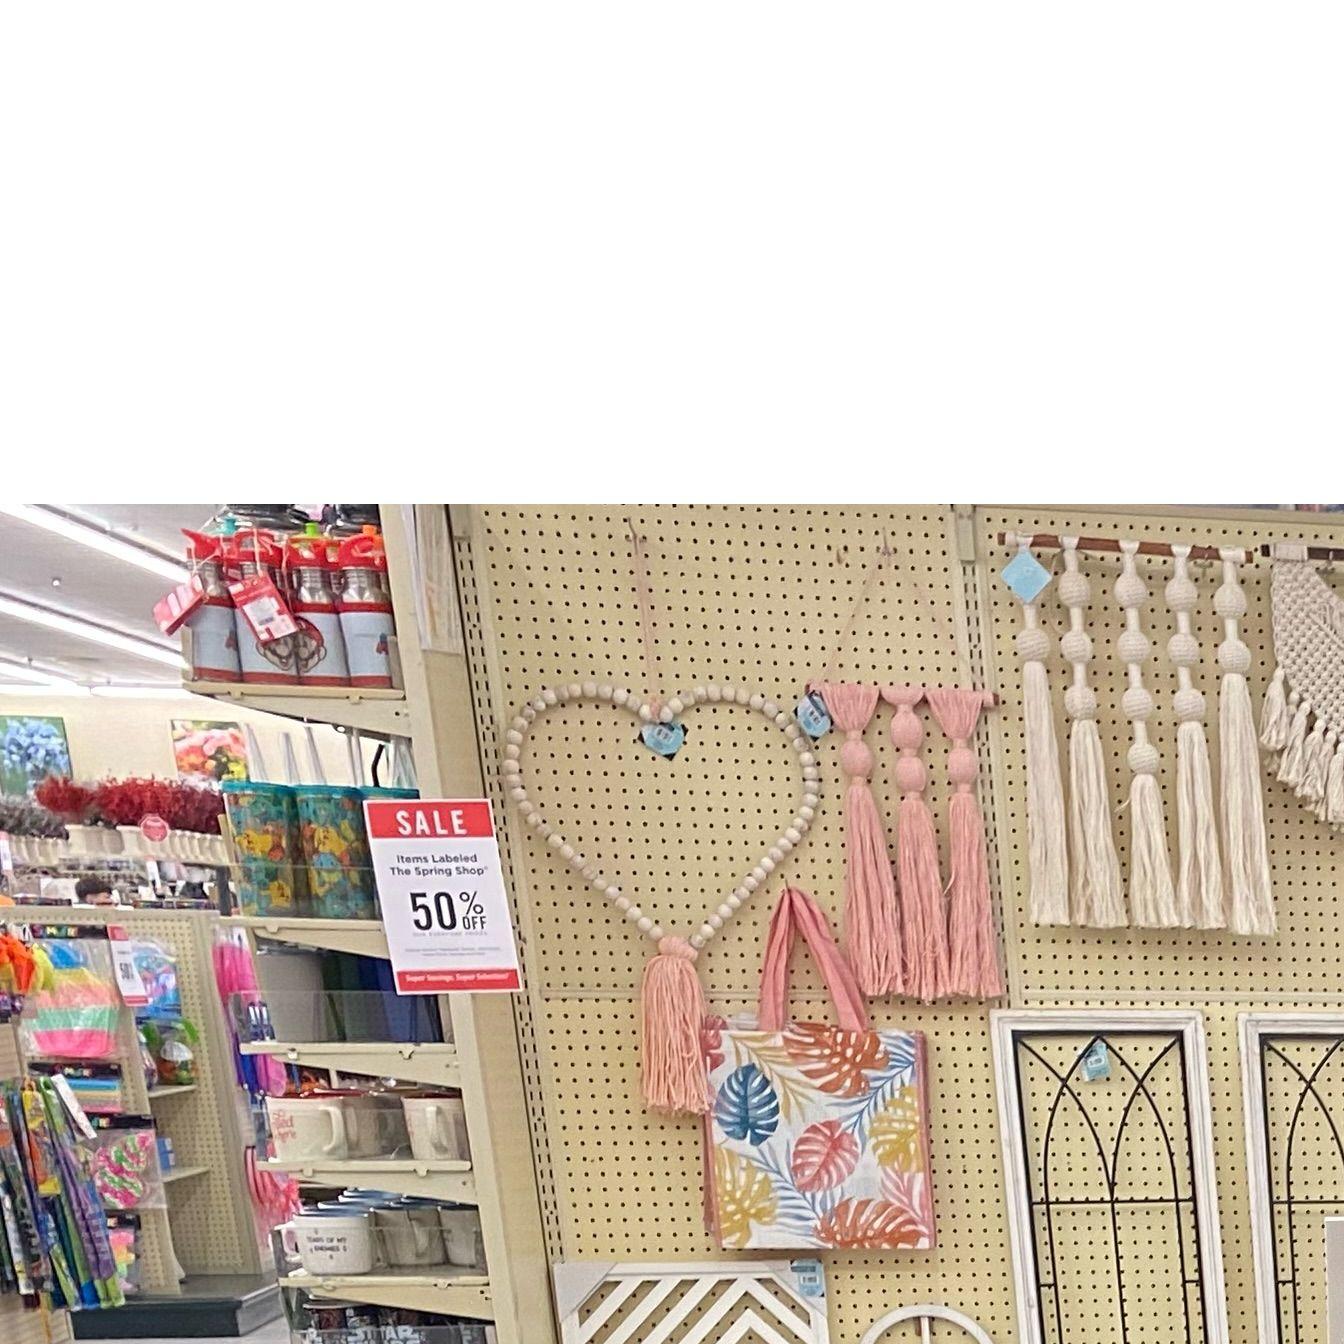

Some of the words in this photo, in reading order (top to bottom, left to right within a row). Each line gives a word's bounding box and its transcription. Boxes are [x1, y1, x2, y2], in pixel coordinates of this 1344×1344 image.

[396, 809, 468, 836] SALE
[396, 855, 429, 864] Items
[432, 854, 478, 863] Labeled
[390, 867, 412, 876] The
[415, 866, 453, 877] Spring
[461, 916, 488, 930] OFF
